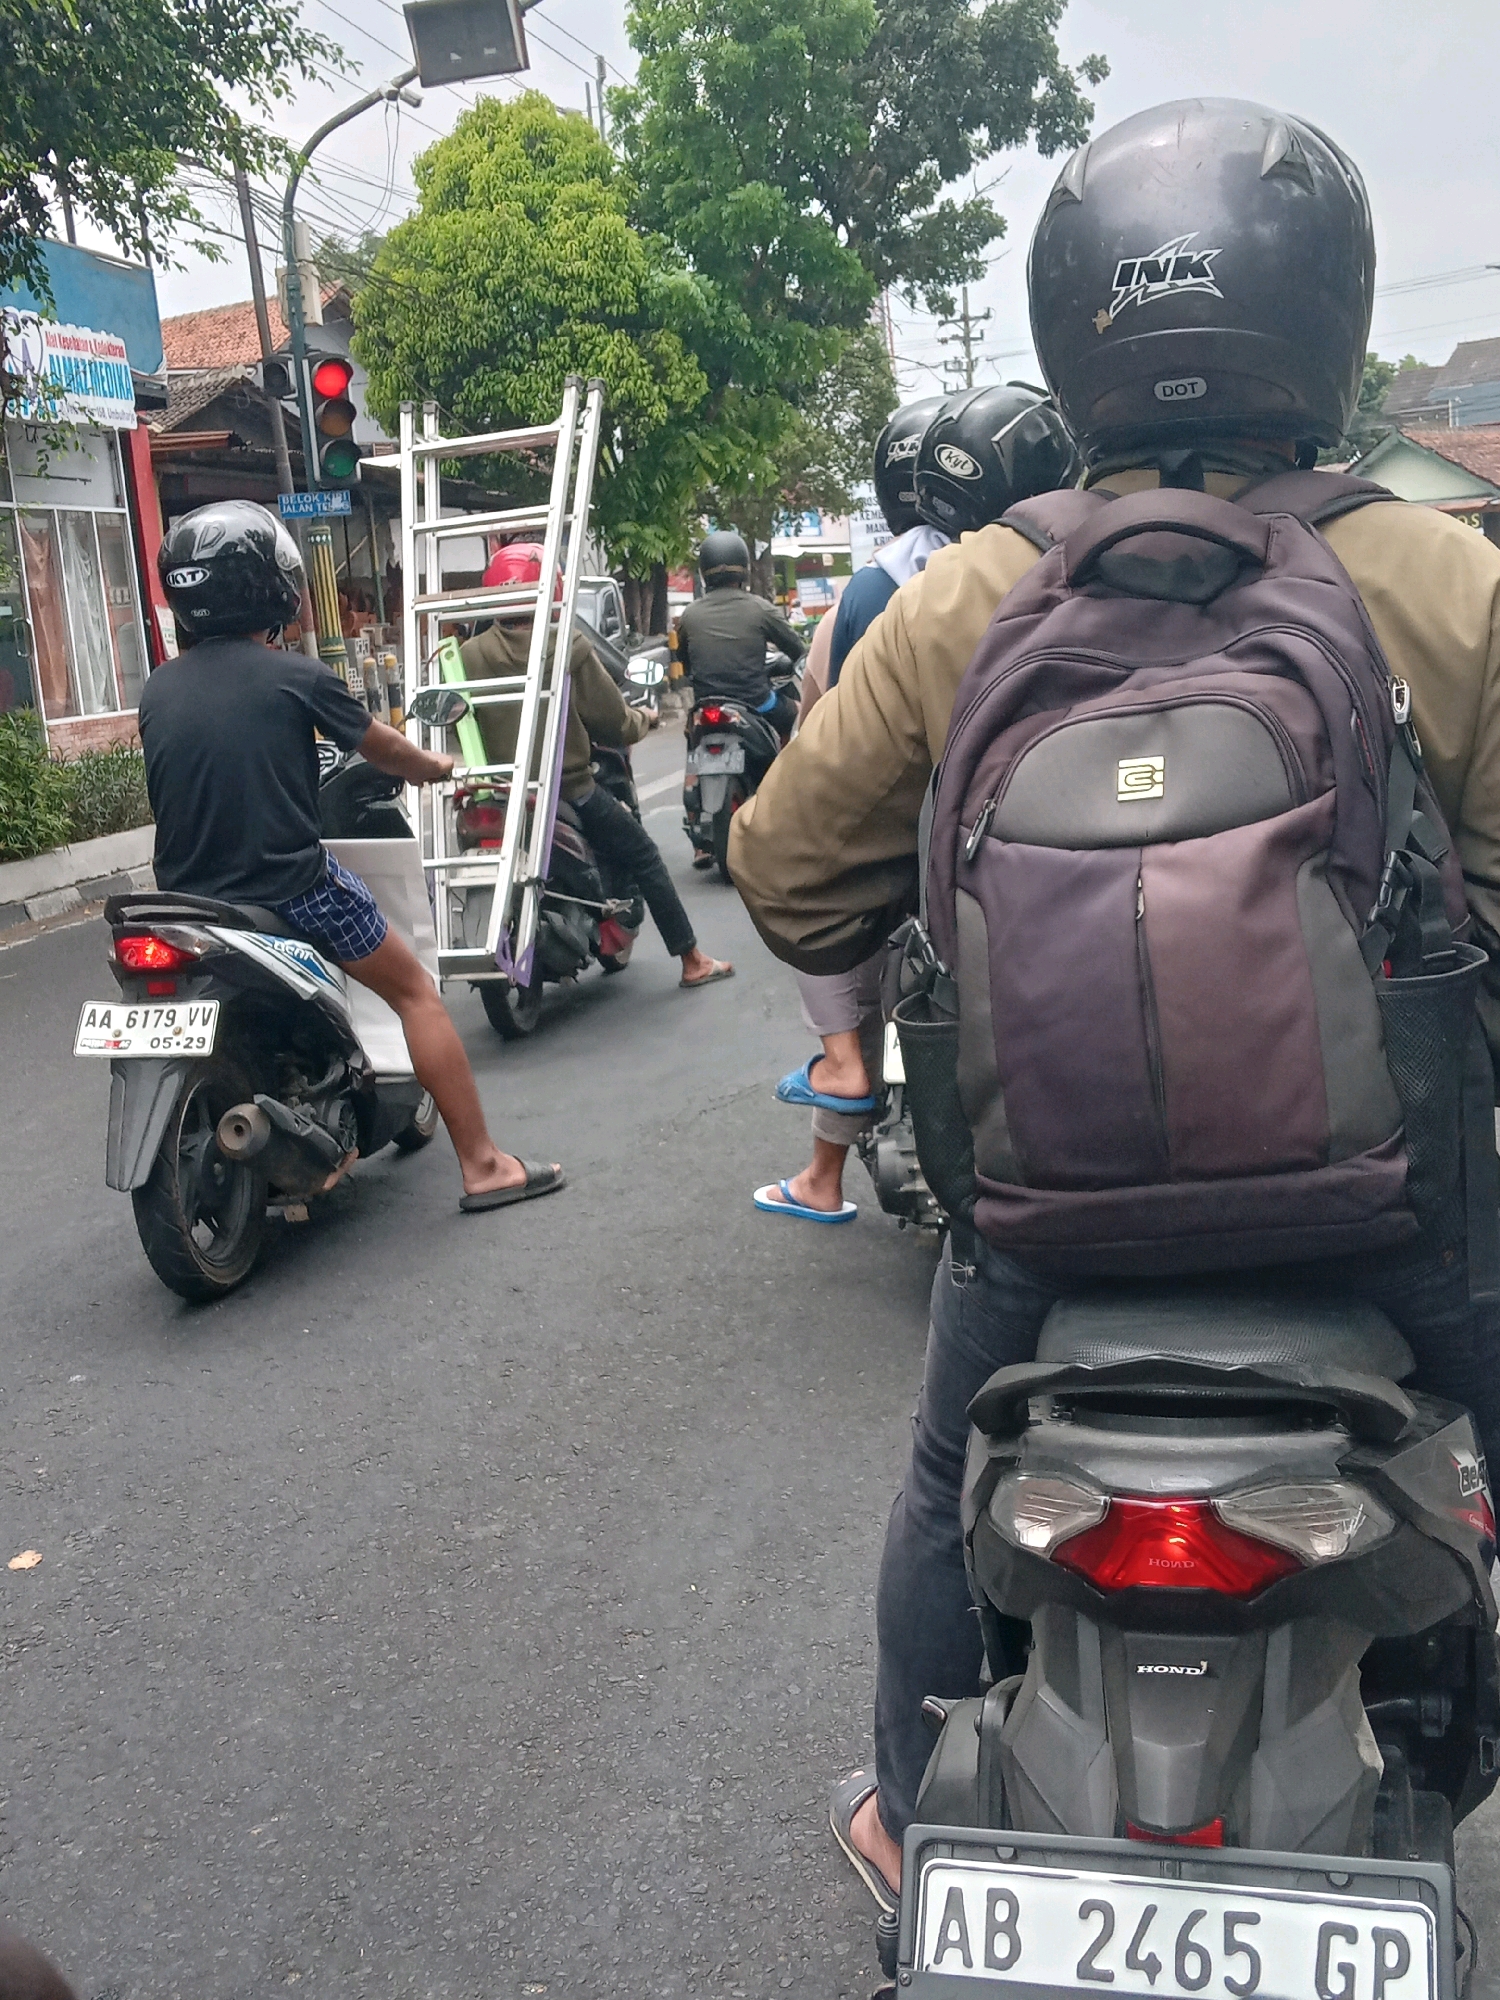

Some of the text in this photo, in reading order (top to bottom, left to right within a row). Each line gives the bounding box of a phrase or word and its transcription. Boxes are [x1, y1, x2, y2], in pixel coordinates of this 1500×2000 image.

[1162, 382, 1199, 397] DOT
[282, 494, 319, 504] BELOK
[282, 503, 314, 513] JALAN
[85, 1007, 213, 1029] AA 6179 VV
[933, 1886, 1412, 2000] AB 2465 GP
